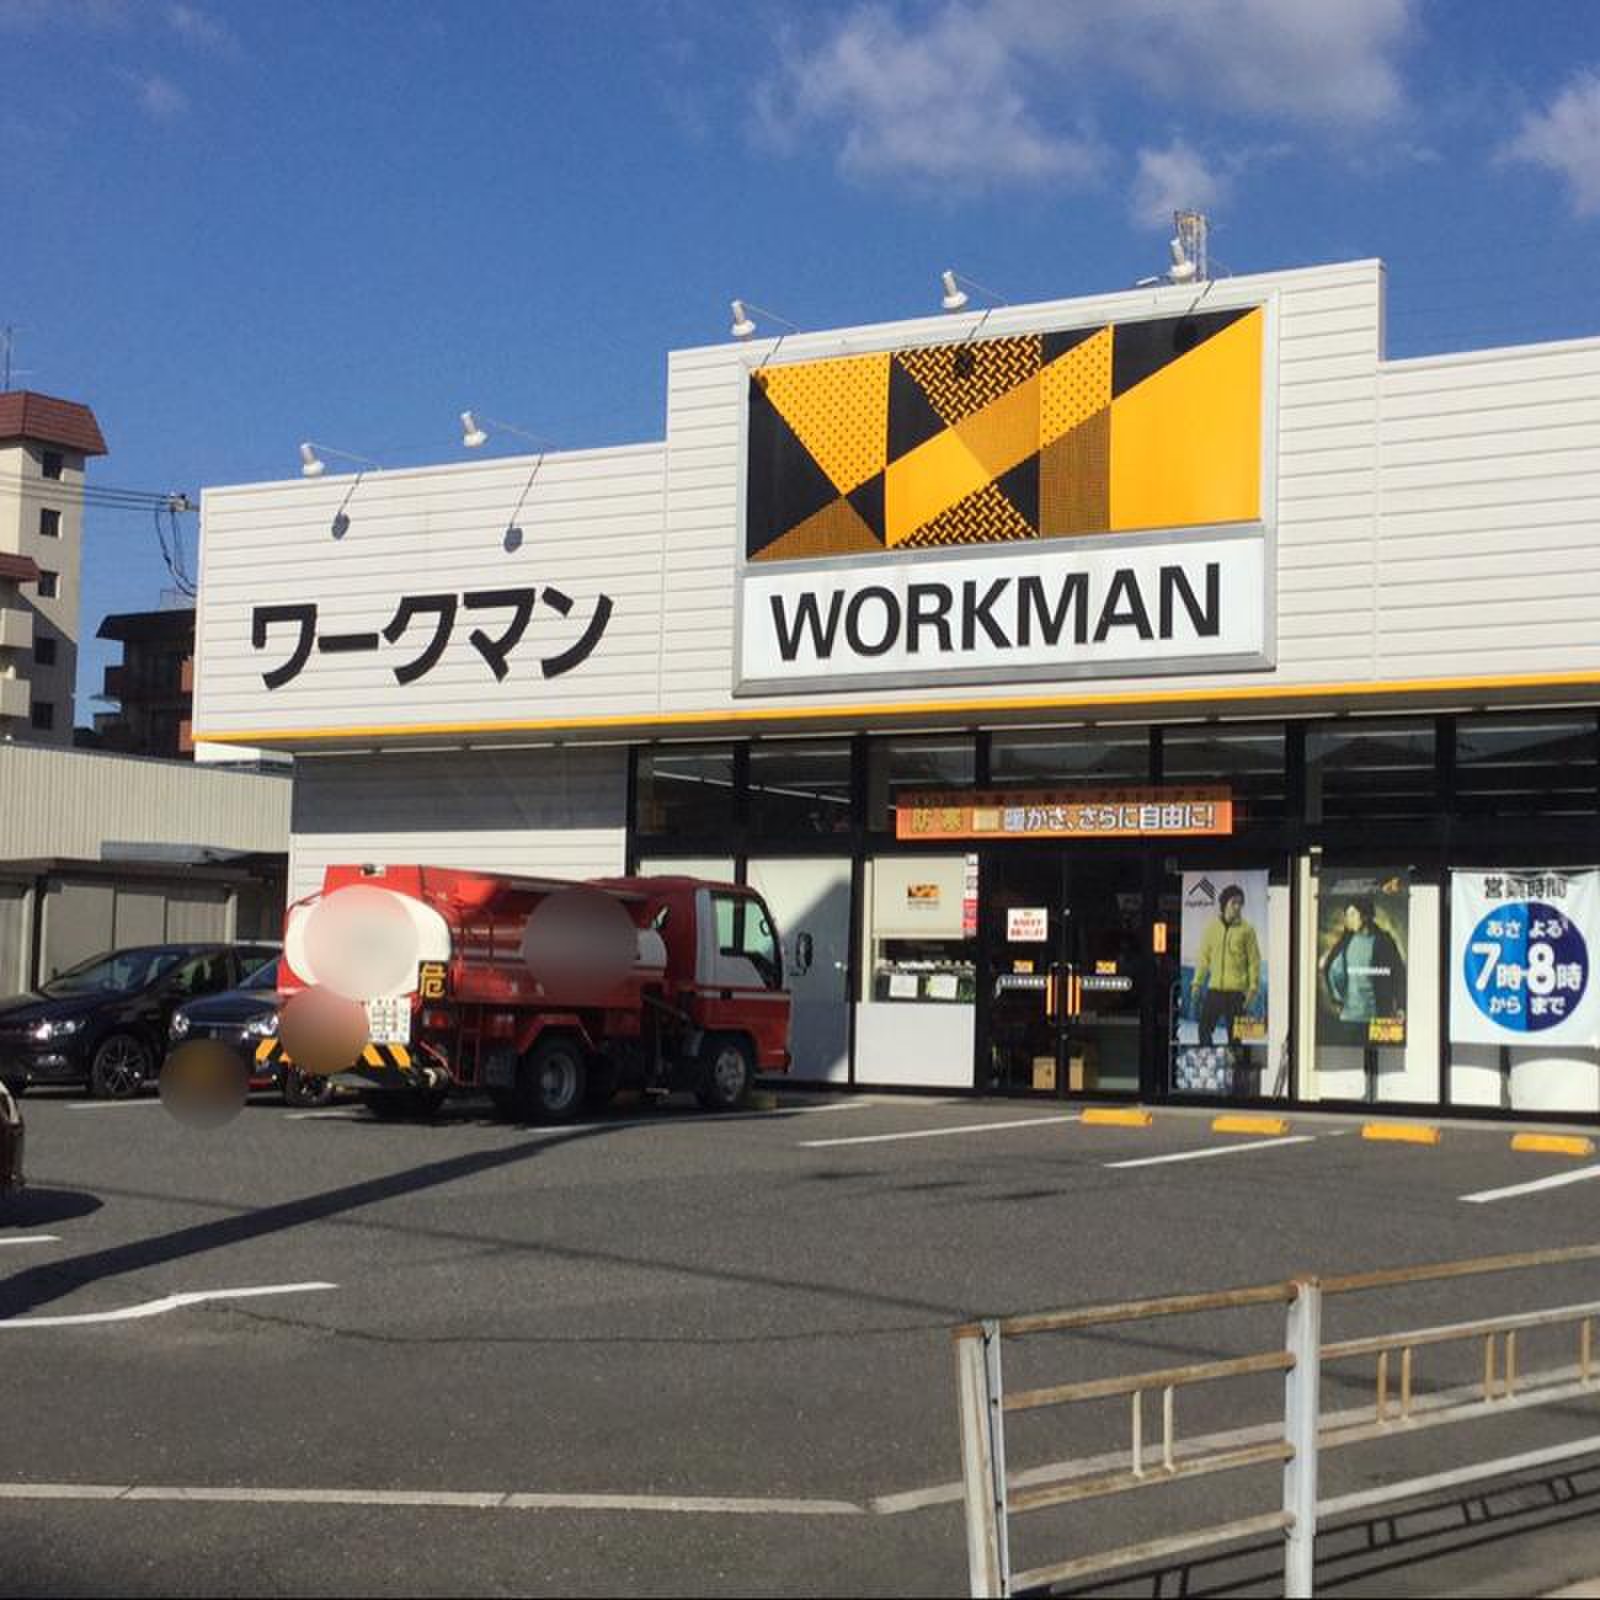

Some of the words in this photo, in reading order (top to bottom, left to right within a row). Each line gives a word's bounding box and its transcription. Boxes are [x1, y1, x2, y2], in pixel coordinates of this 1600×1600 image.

[252, 586, 613, 690] ワークマン
[770, 563, 1220, 661] WORKMAN
[421, 962, 446, 998] 危
[1489, 996, 1521, 1014] から
[1530, 996, 1566, 1015] まで
